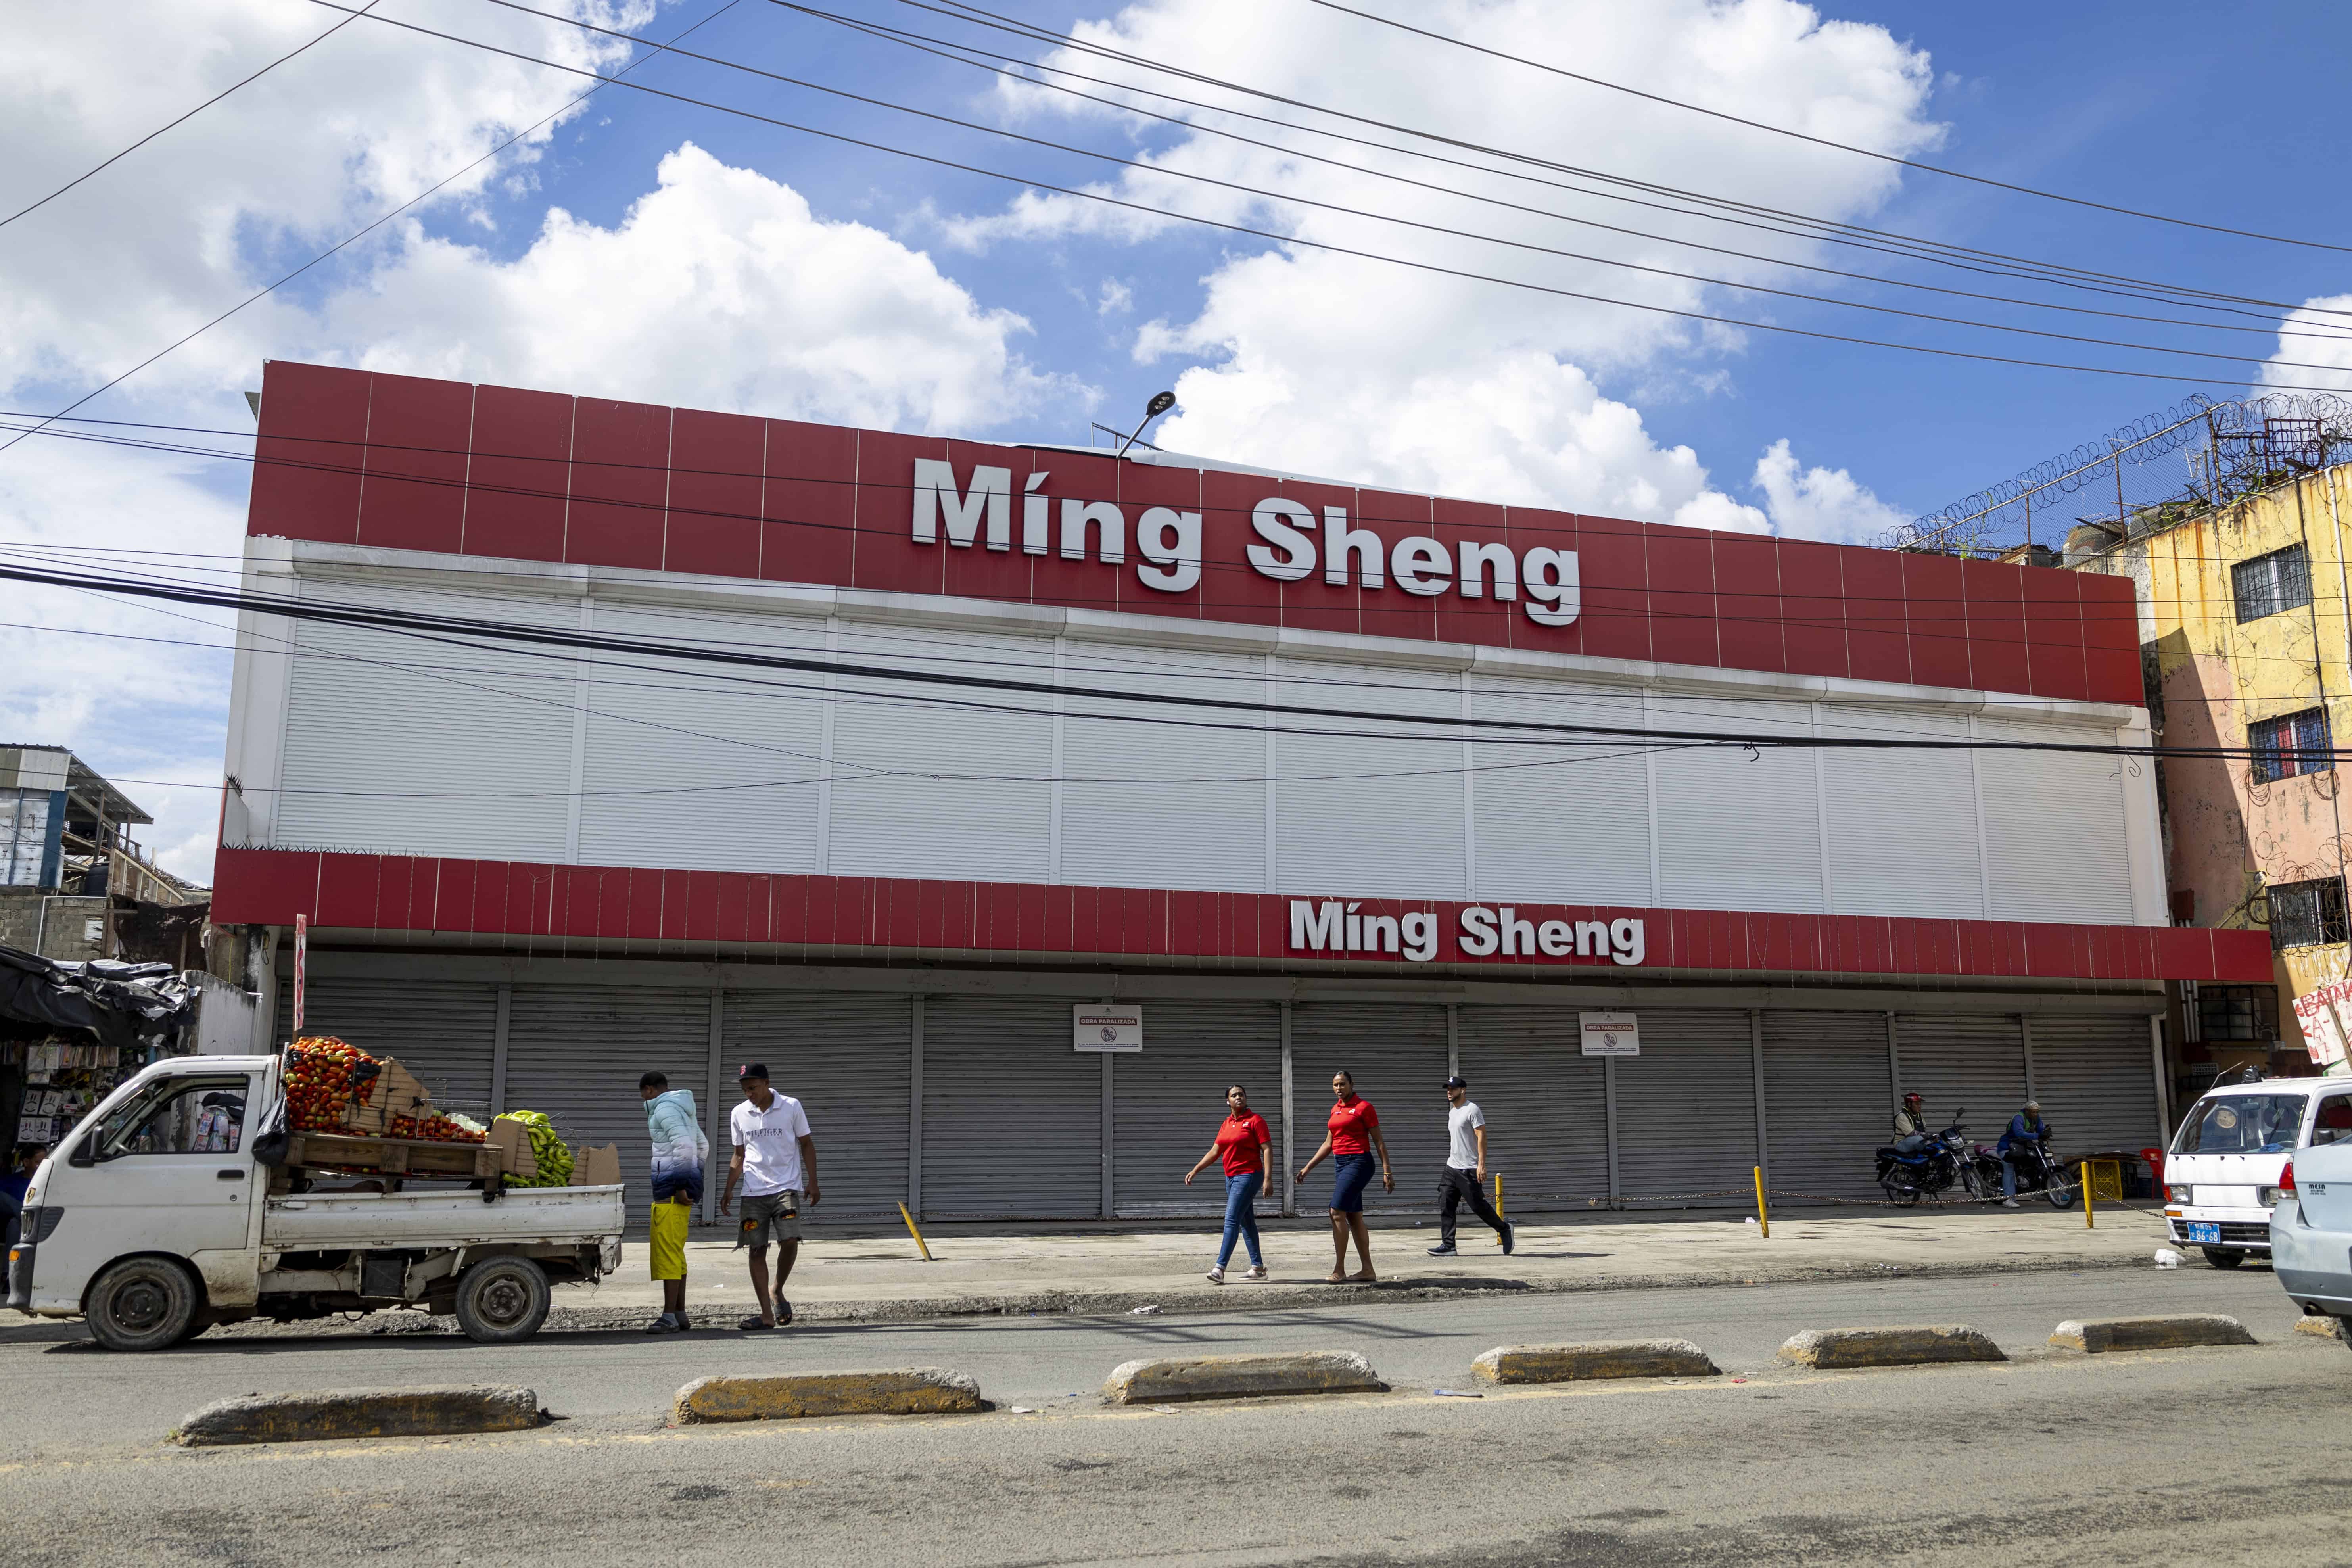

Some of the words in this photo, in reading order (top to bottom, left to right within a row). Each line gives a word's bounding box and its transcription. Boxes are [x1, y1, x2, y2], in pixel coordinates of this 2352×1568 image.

[911, 458, 1202, 591] Míng
[1246, 497, 1581, 626] Sheng
[1290, 900, 1438, 962] Míng
[1458, 906, 1646, 965] Sheng
[2197, 1230, 2218, 1242] 86-68
